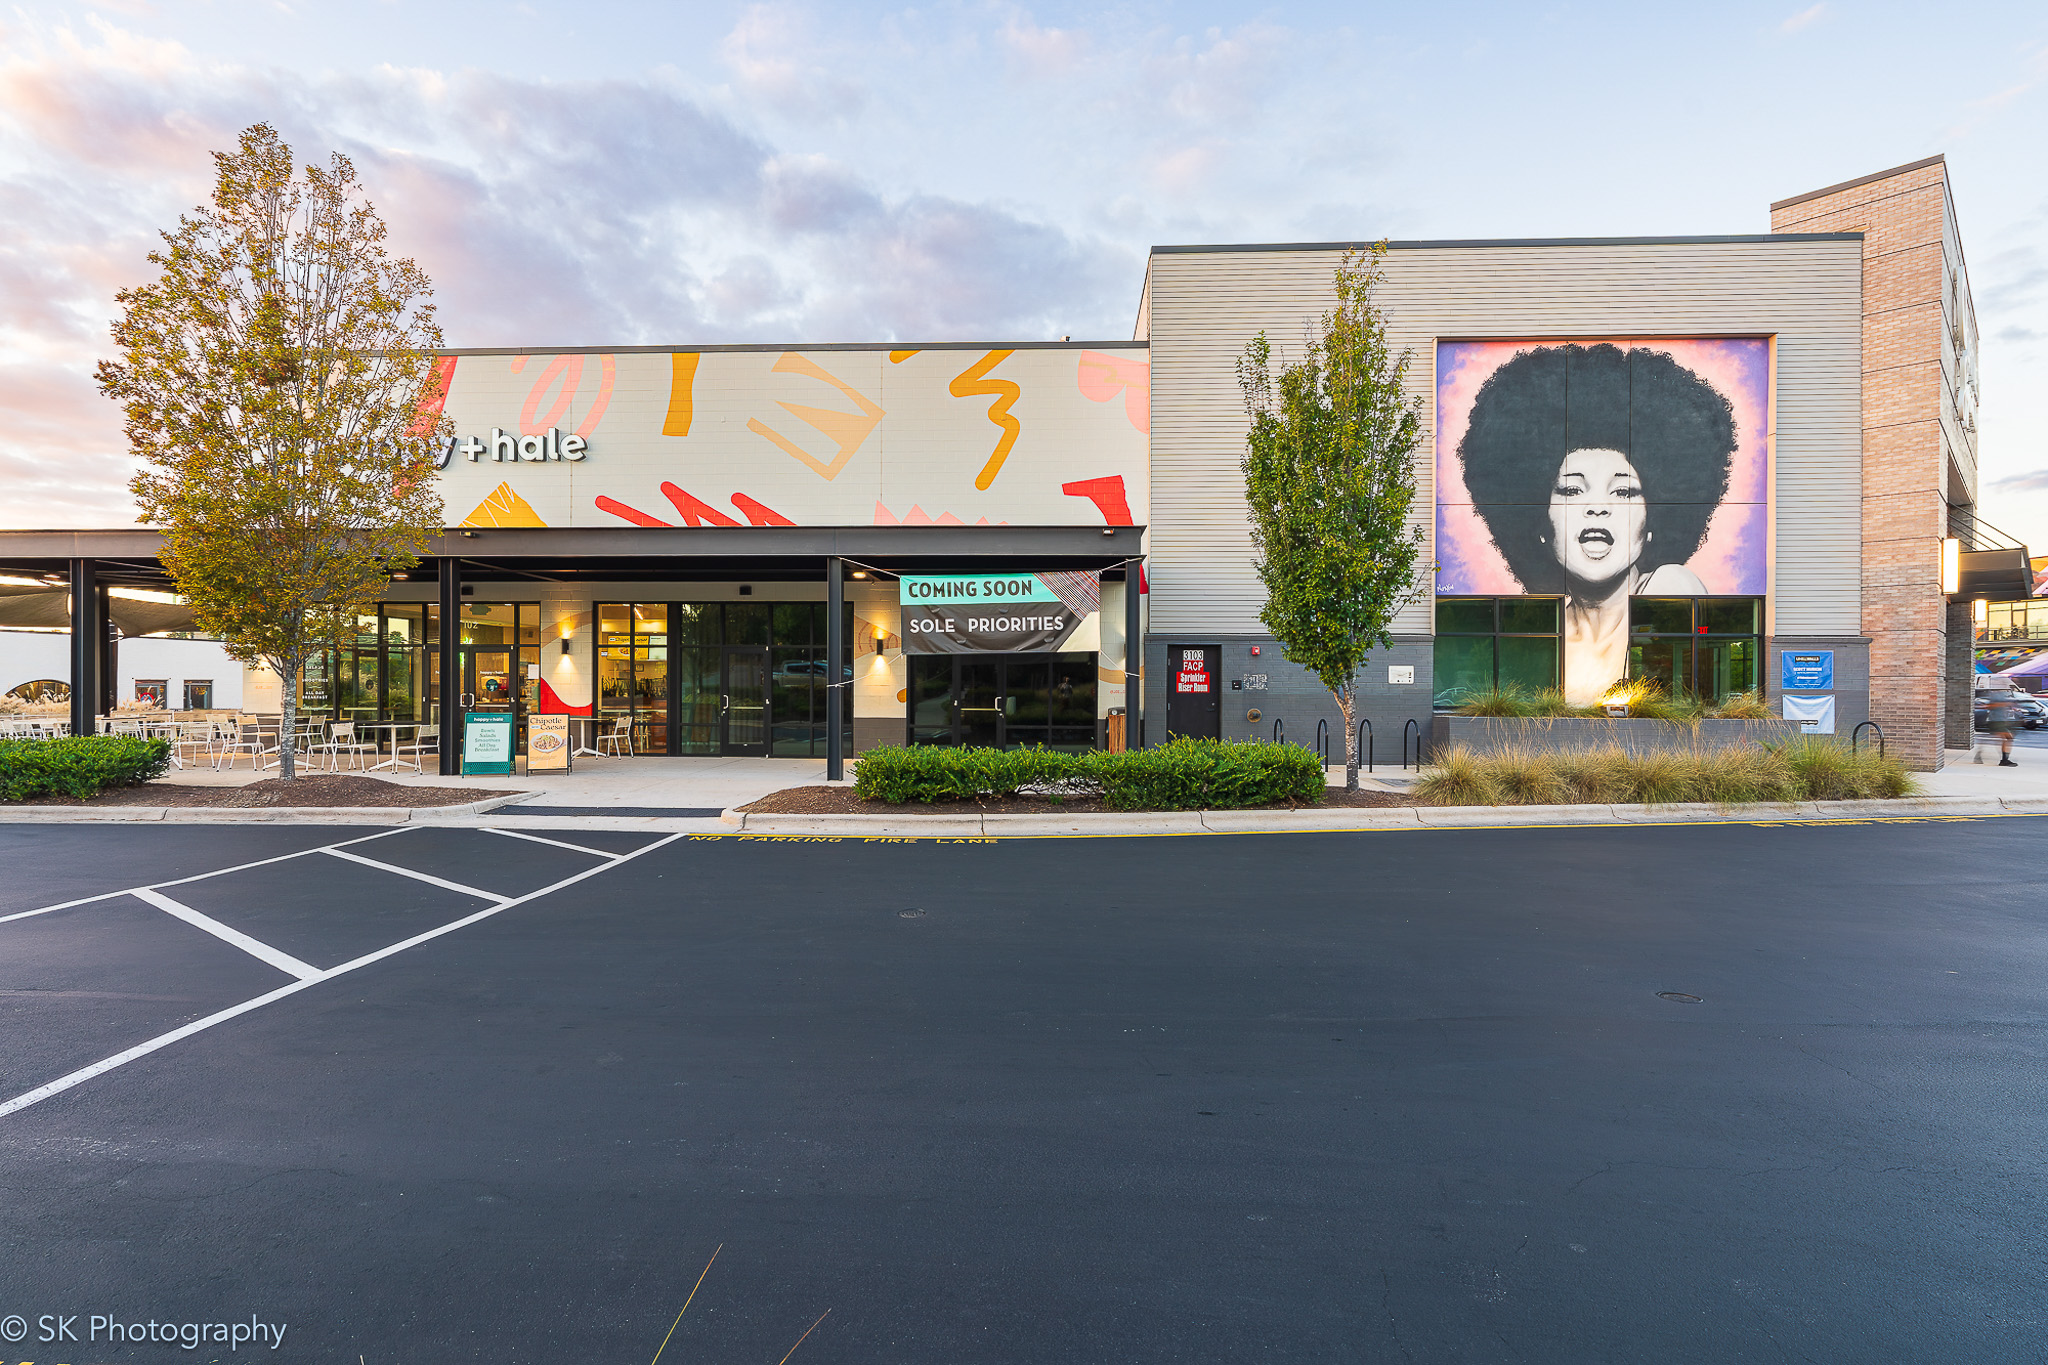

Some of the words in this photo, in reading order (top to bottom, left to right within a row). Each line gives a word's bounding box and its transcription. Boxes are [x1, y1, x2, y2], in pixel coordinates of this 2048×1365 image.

[491, 427, 589, 462] hale
[908, 580, 977, 598] COMING
[983, 579, 1032, 597] SOON
[909, 618, 956, 633] SOLE
[968, 616, 1064, 633] PRIORITIES
[1184, 650, 1203, 660] 3103
[1183, 662, 1203, 671] FACP
[1180, 673, 1206, 683] Sprinkler
[1178, 683, 1193, 692] Riser
[1193, 683, 1208, 692] Room
[530, 717, 562, 725] Chipotle
